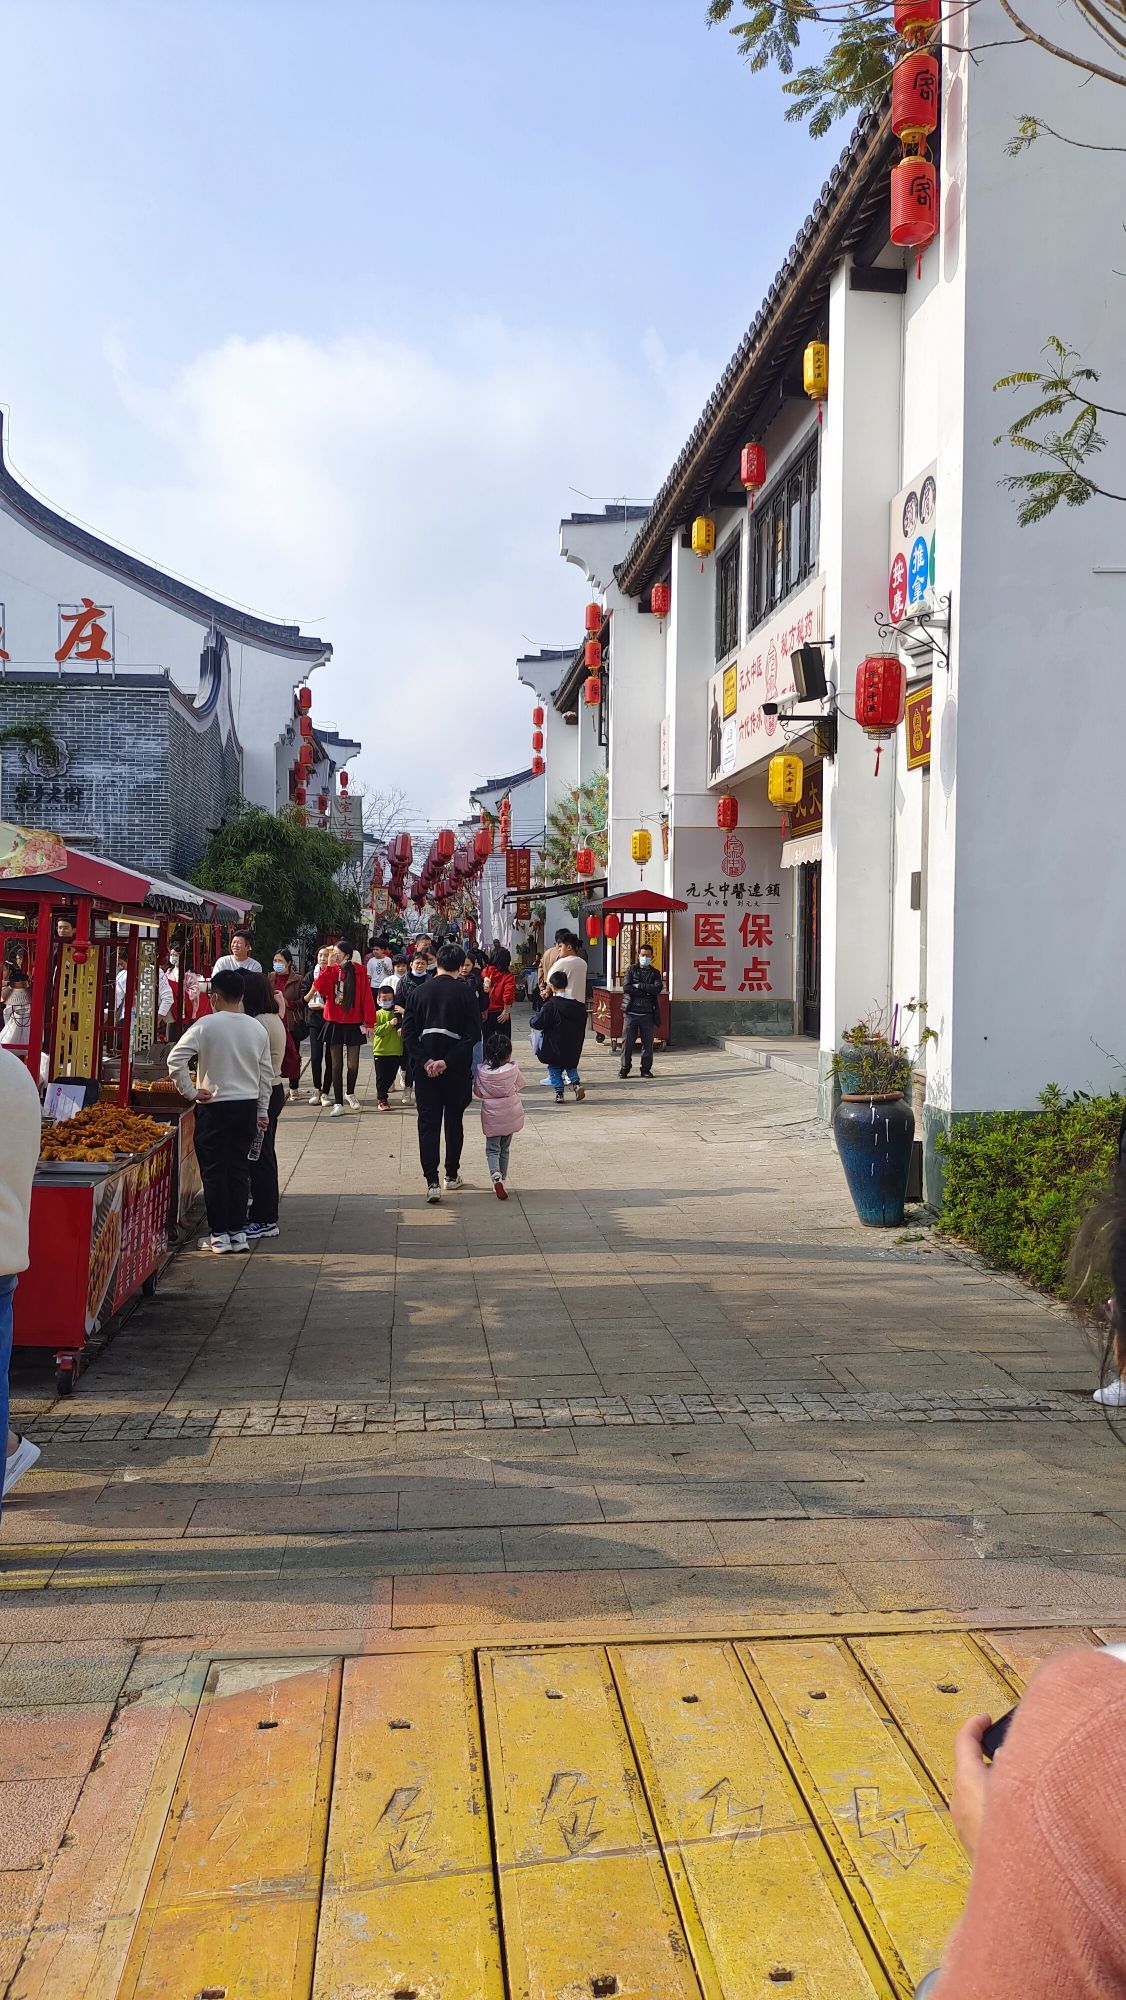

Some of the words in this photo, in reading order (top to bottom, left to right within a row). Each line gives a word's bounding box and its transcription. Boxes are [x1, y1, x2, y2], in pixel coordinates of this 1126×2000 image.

[912, 69, 937, 106] 客
[909, 174, 932, 211] 客
[892, 559, 904, 617] 按摩
[912, 545, 925, 602] 推拿
[738, 654, 763, 693] 元大中医
[694, 912, 774, 948] 医保
[692, 956, 773, 992] 定点
